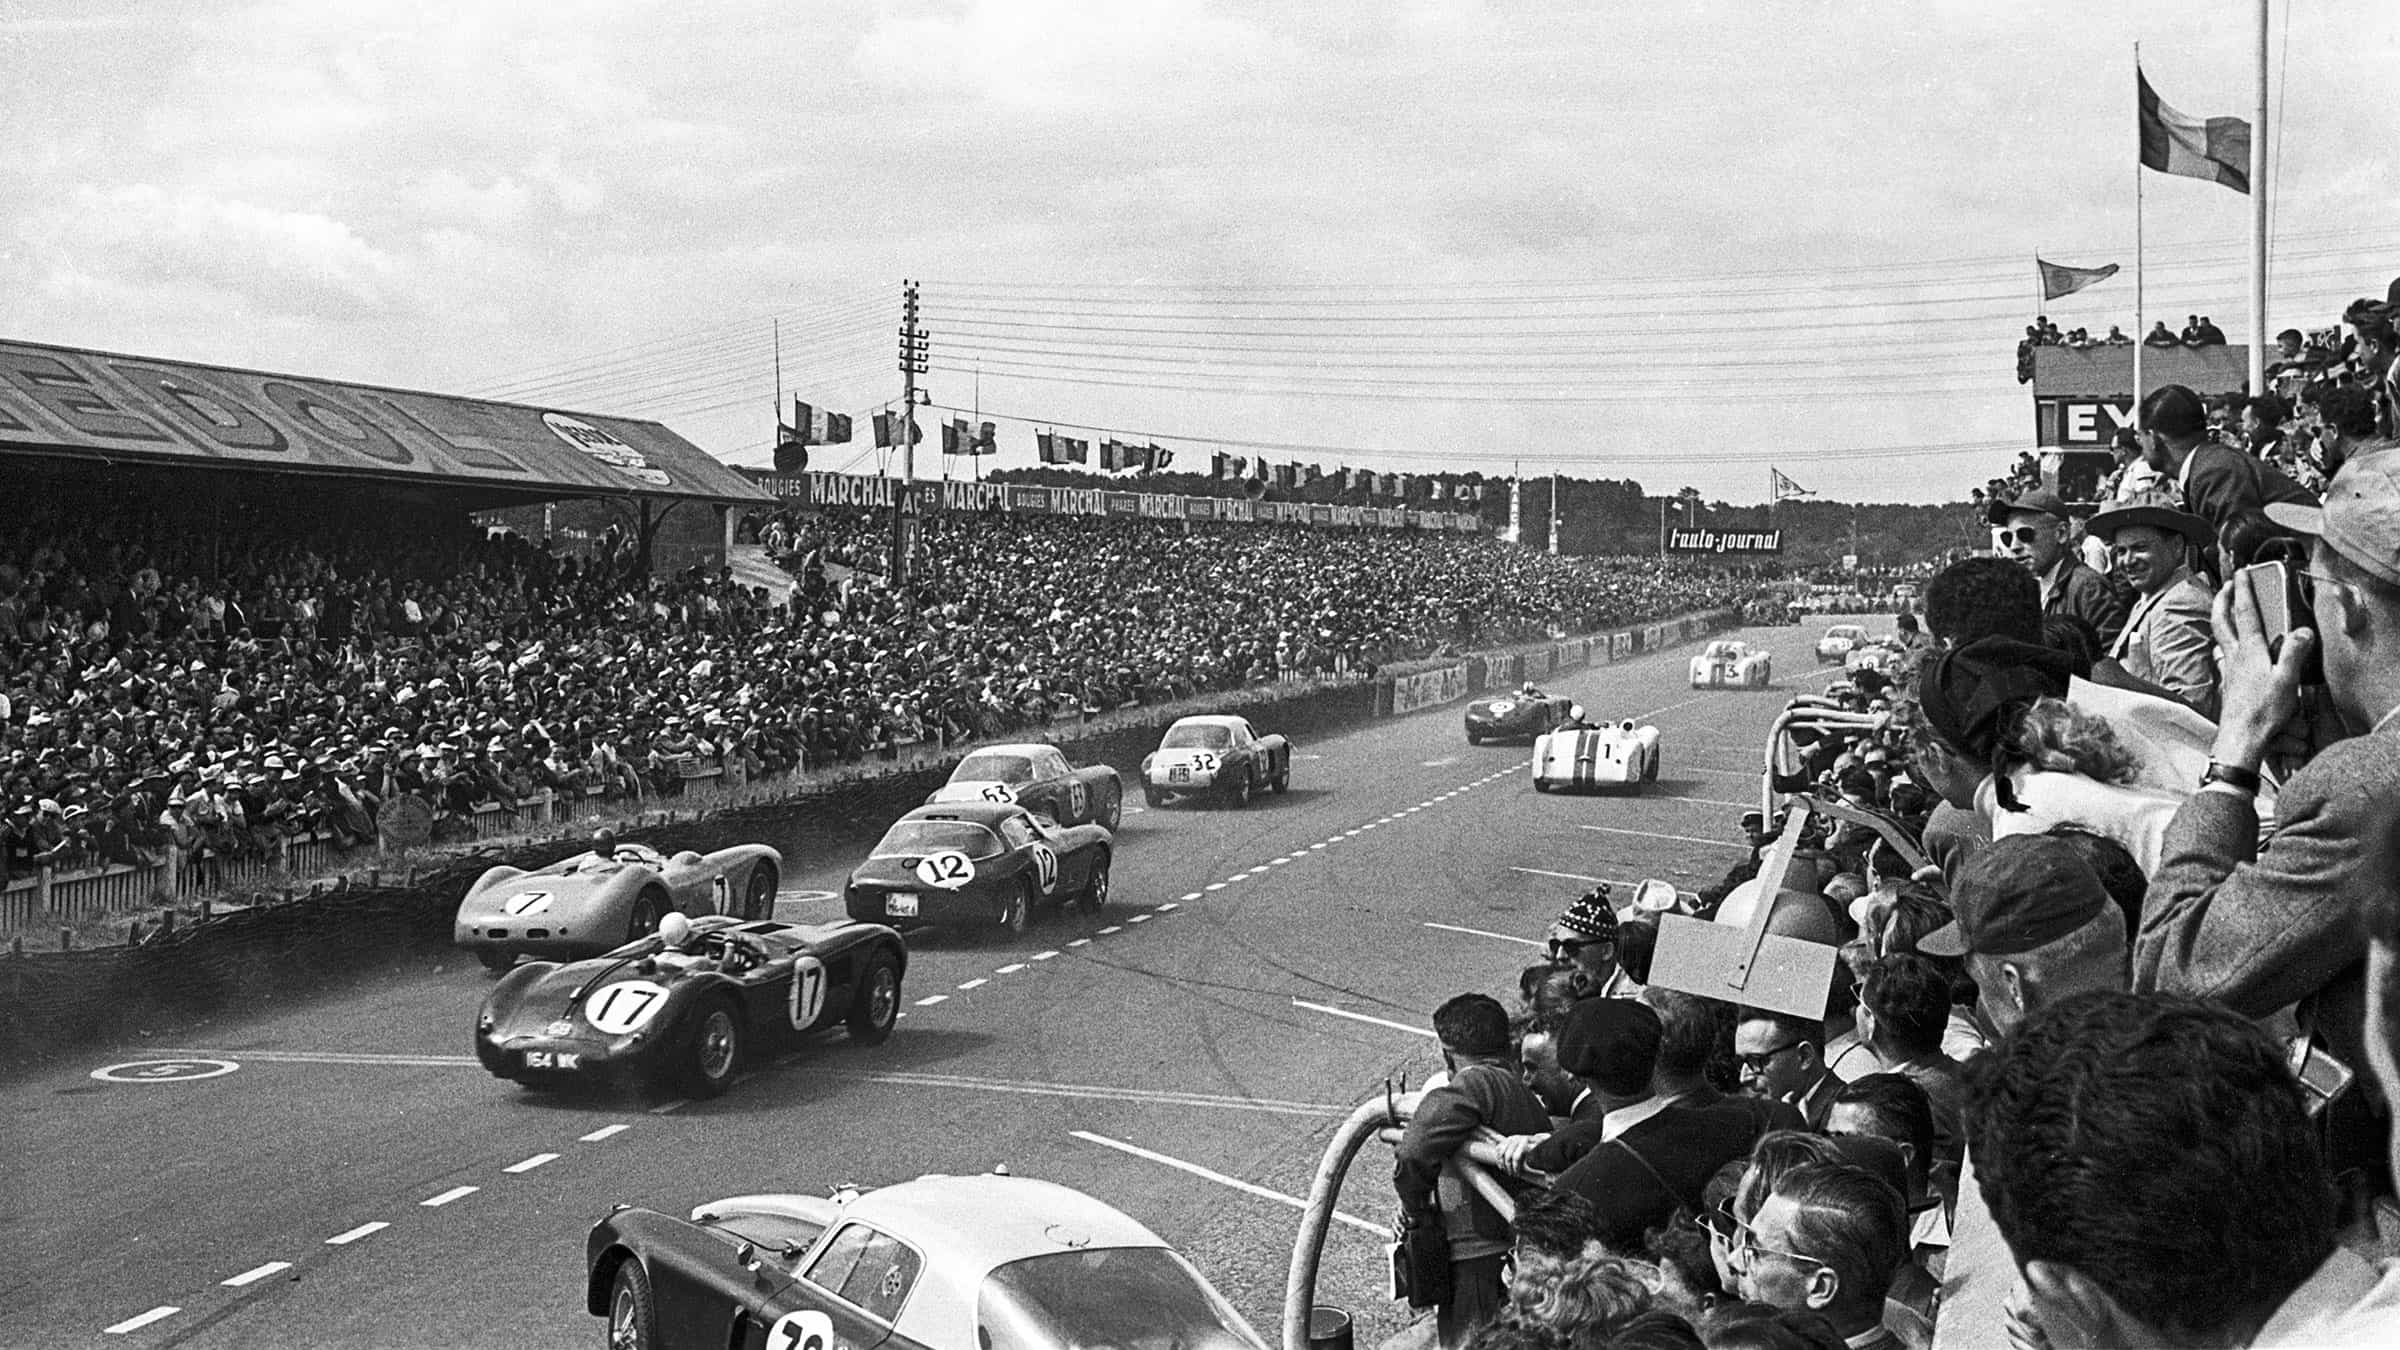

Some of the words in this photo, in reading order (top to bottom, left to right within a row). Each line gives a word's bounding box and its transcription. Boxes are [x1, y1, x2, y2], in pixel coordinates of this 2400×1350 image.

[0, 350, 529, 474] EDOL
[810, 473, 896, 508] MARCHAL
[1050, 489, 1107, 516] MARCHAL
[1192, 753, 1216, 772] 32
[1604, 743, 1612, 760] 1
[925, 855, 969, 884] 12
[1036, 848, 1056, 889] 12
[515, 890, 547, 915] 7
[714, 876, 726, 915] 7
[597, 988, 659, 1026] 17
[796, 966, 822, 1021] 17
